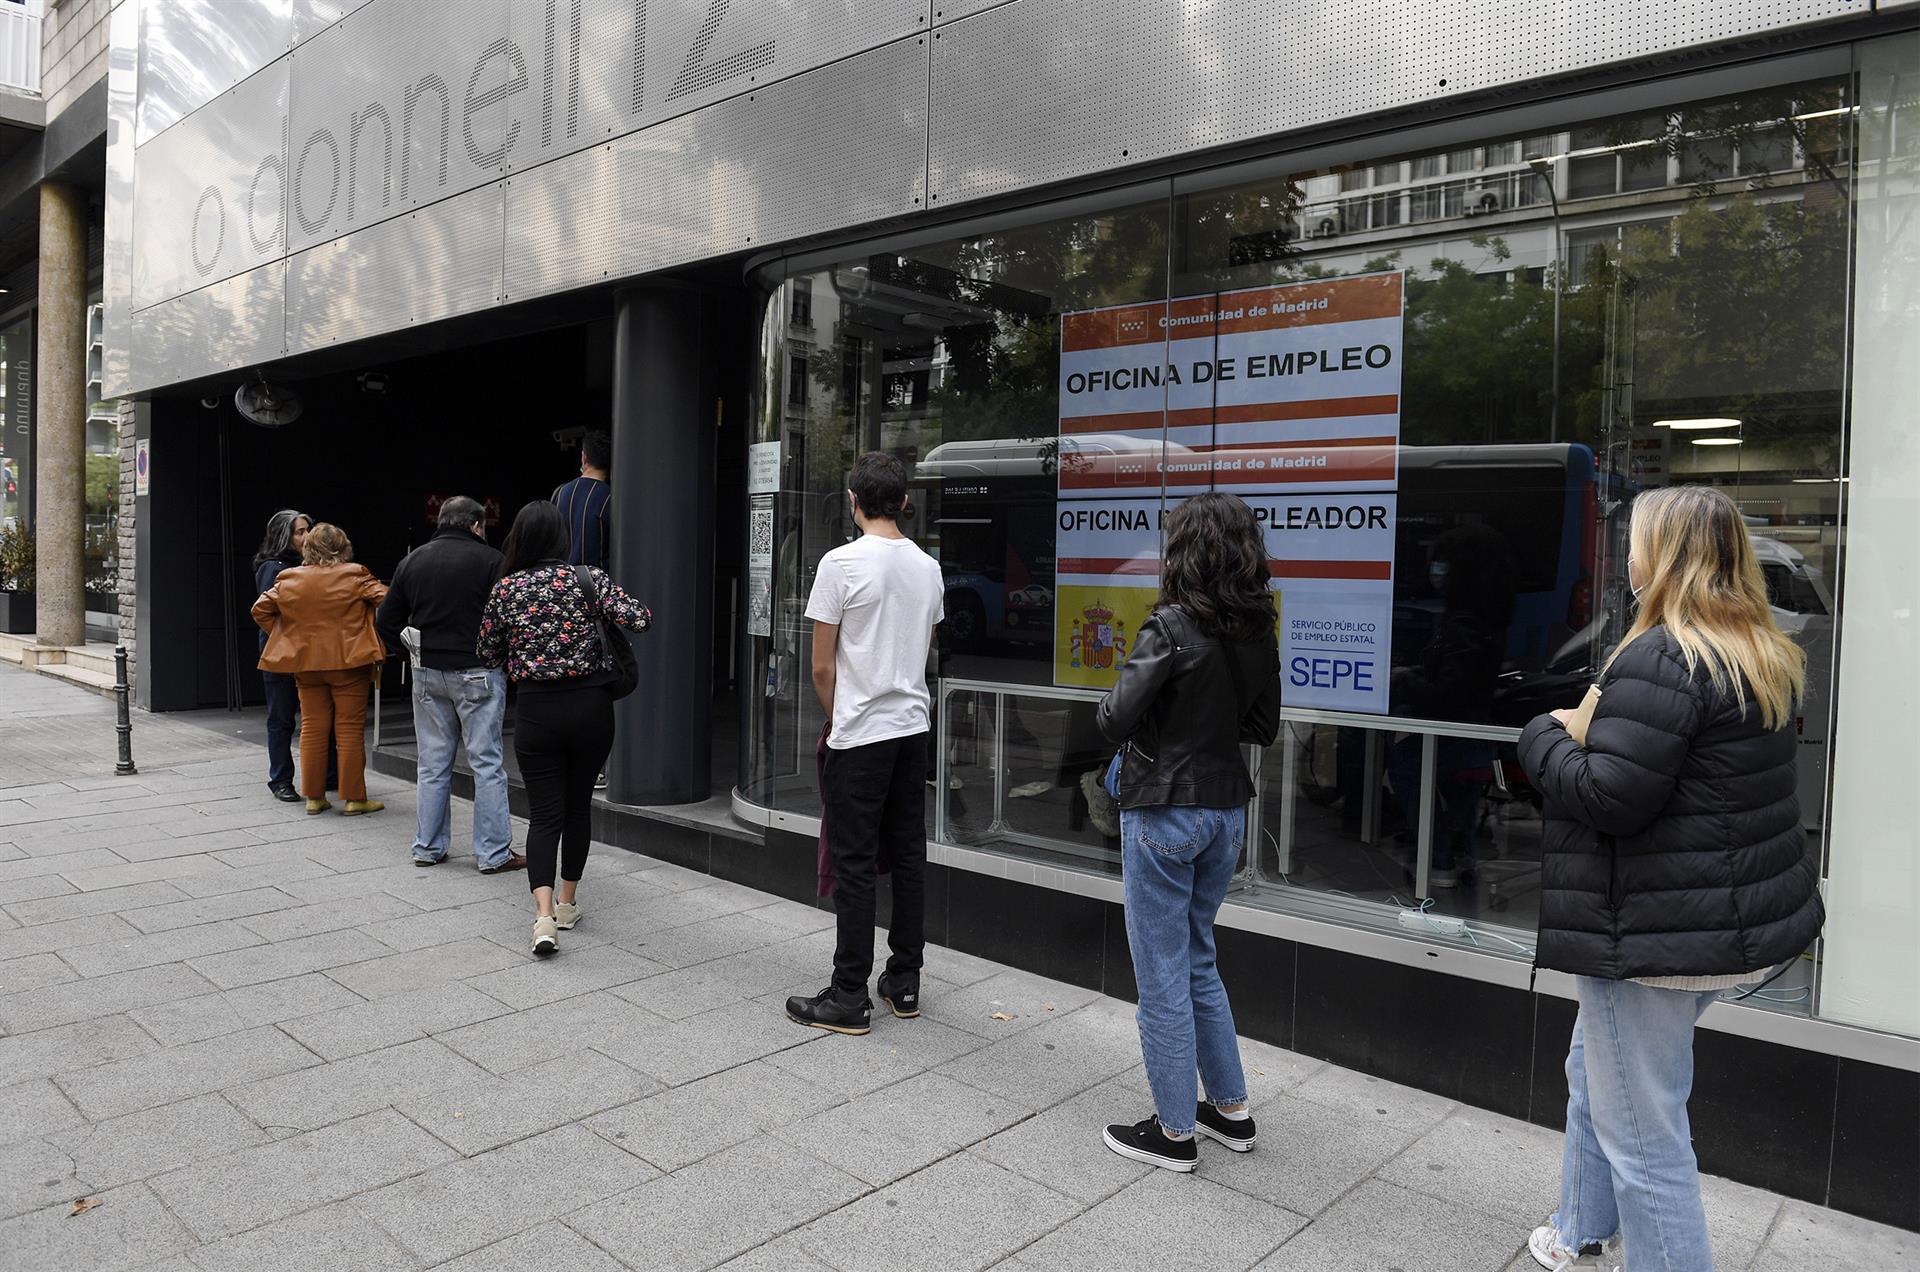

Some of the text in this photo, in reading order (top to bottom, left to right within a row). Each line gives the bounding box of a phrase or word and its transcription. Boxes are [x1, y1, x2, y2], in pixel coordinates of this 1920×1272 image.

[1158, 298, 1329, 328] Comunidad de Madrid
[1066, 344, 1392, 394] OFICINA DE EMPLEO
[1156, 456, 1328, 473] Comunidad de Madrid
[1059, 509, 1150, 531] OFICINA
[1253, 505, 1388, 530] PLEADOR
[1291, 620, 1376, 632] SERVICIO PÚBLICO
[1291, 632, 1375, 644] DE EMPLEO ESTATAL
[1290, 657, 1374, 692] SEPE
